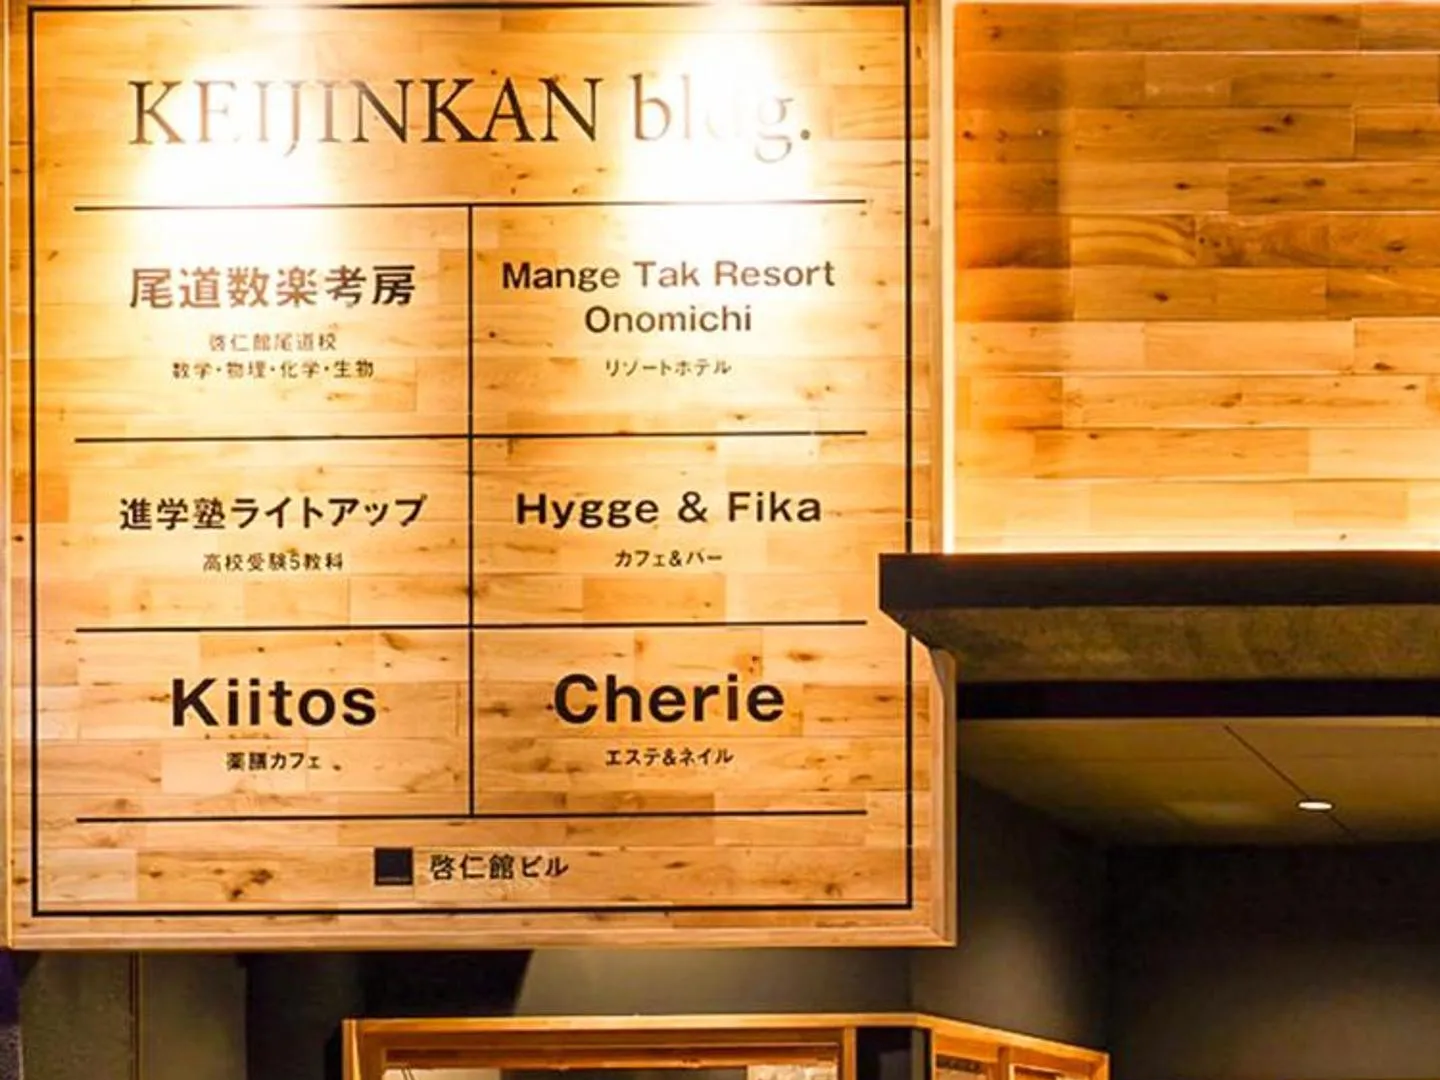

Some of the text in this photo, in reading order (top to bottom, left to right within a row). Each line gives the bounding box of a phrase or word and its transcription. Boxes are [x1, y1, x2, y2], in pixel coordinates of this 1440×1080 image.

[128, 77, 604, 157] KEIJINKAN
[130, 264, 416, 309] 尾道数楽考房
[502, 260, 836, 292] Mange Tak Resort
[584, 305, 752, 333] Onomichi
[119, 494, 428, 530] 進学塾ライトアップ
[516, 491, 822, 529] Hygge & Fika
[203, 552, 344, 572] 高校受験5教科
[172, 677, 377, 727] Kiitos
[554, 673, 785, 724] Cherie
[430, 853, 570, 880] 啓仁館ビル
